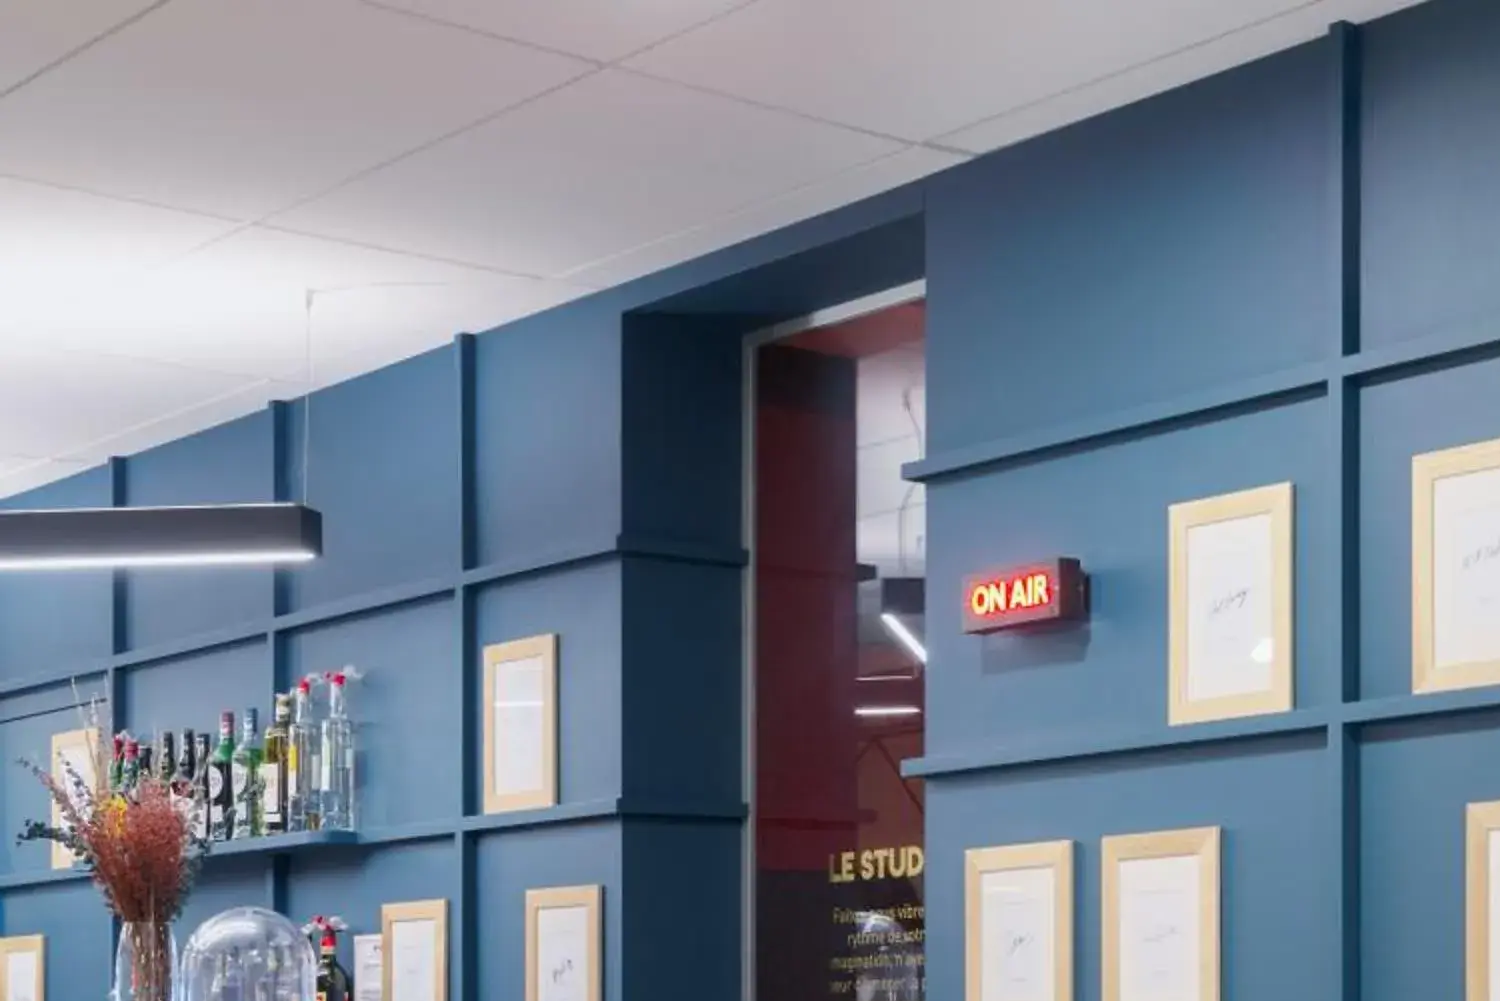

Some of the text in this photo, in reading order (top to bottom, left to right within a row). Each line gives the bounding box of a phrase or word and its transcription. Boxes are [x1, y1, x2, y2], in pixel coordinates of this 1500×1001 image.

[970, 573, 1049, 615] ON AIR
[829, 845, 925, 883] LE STUD
